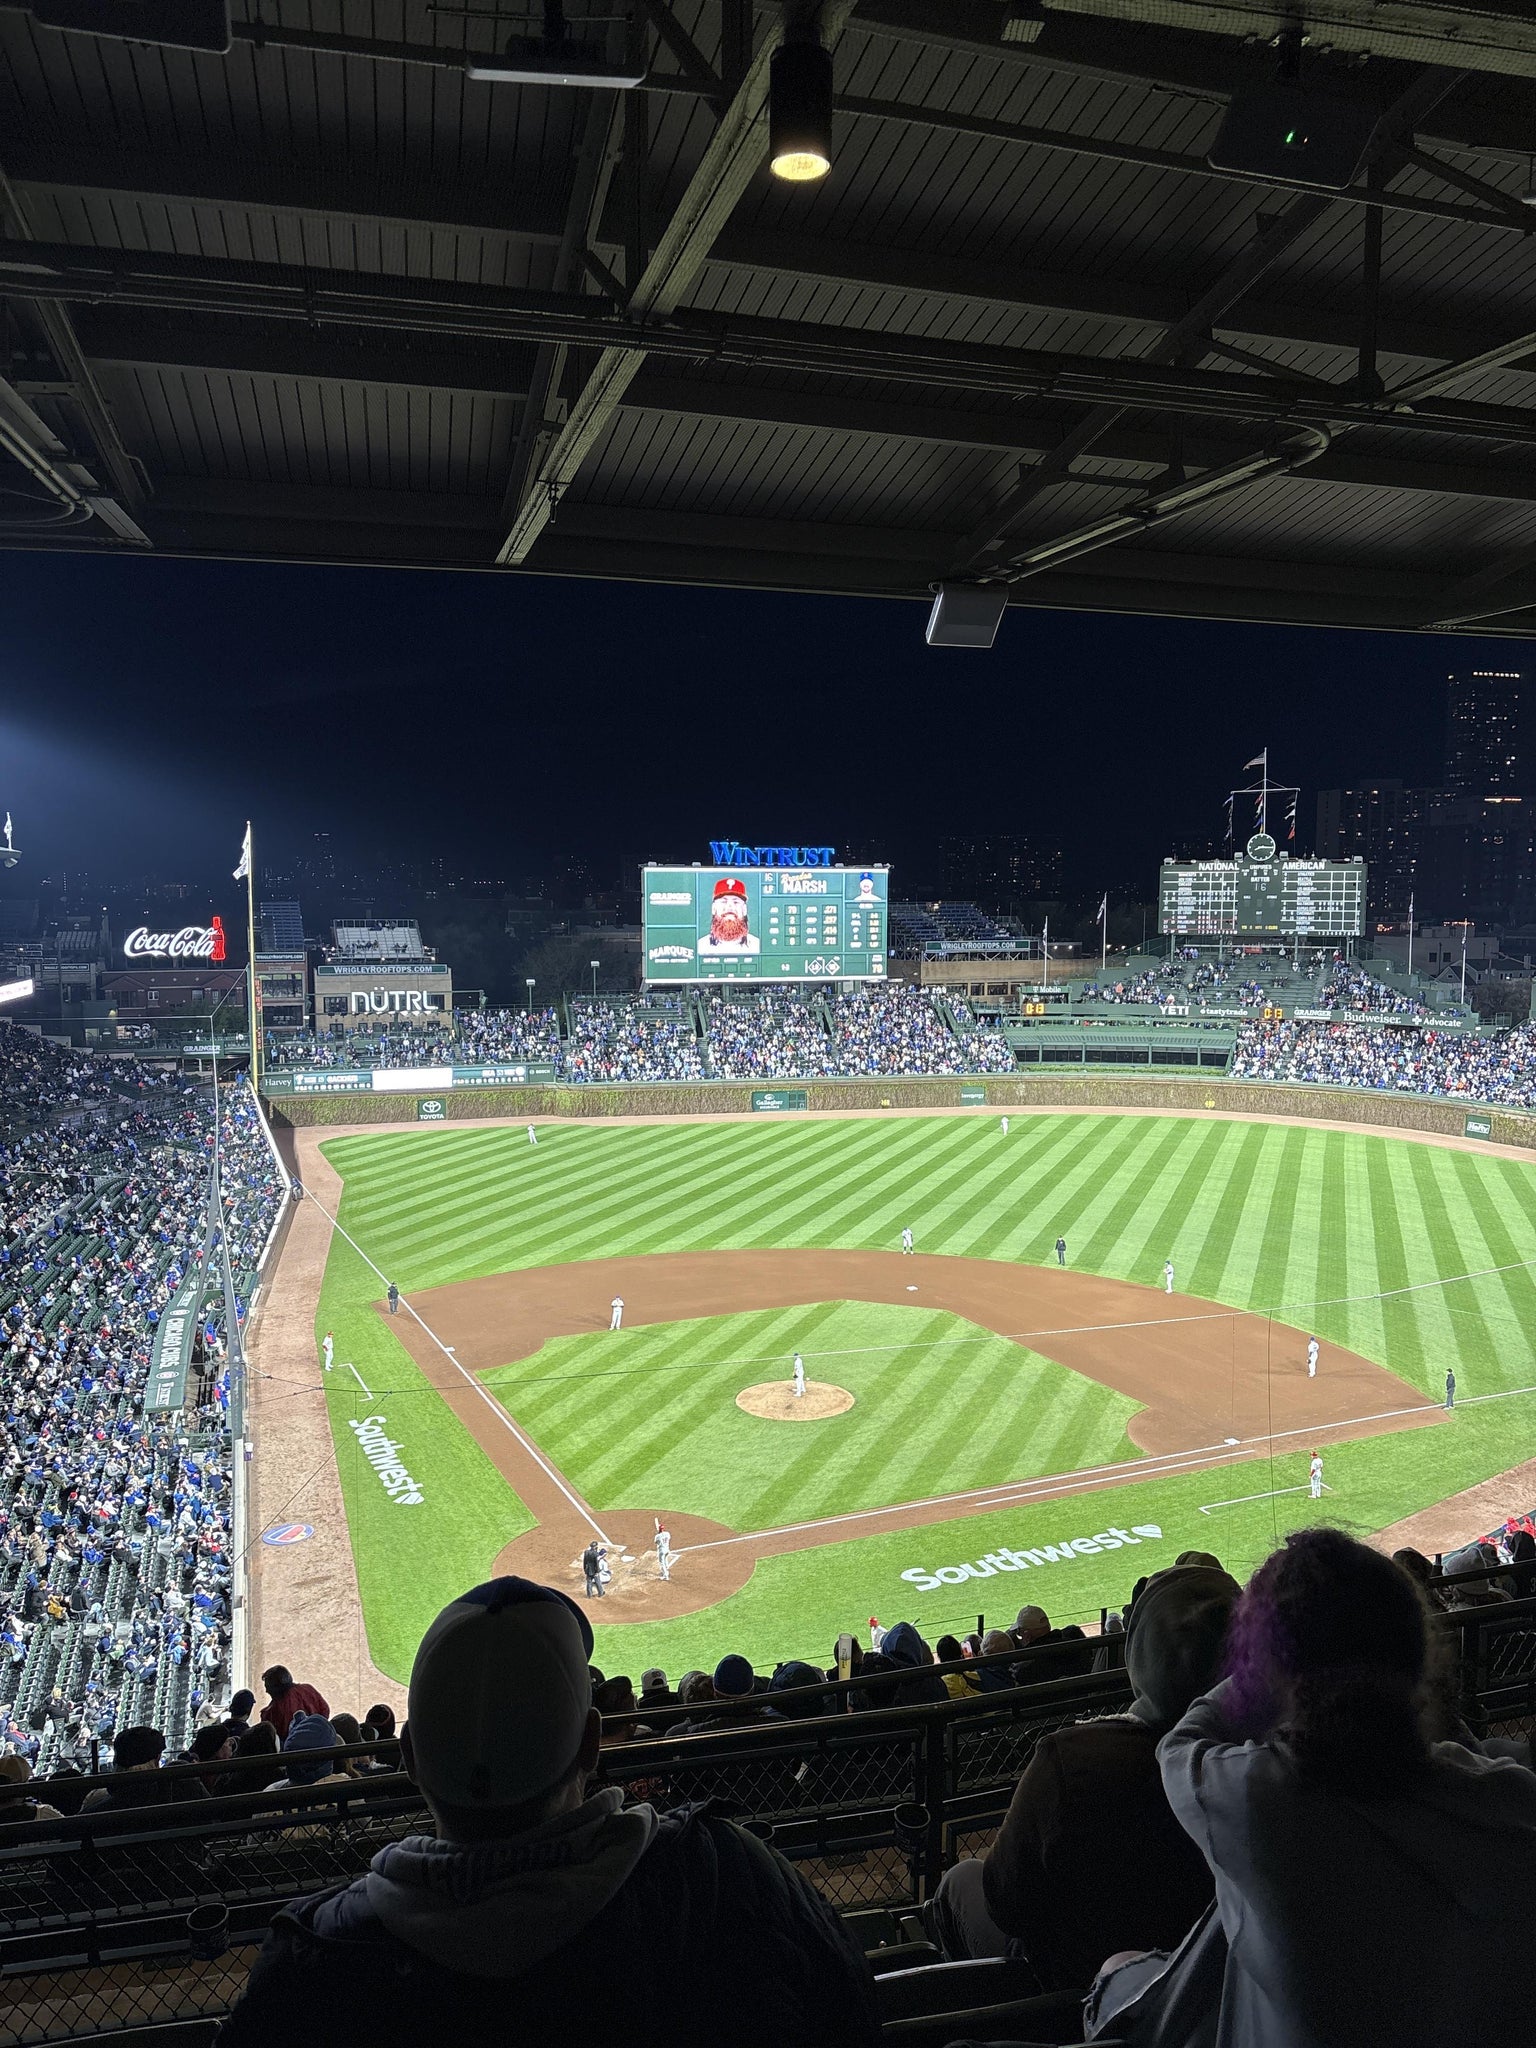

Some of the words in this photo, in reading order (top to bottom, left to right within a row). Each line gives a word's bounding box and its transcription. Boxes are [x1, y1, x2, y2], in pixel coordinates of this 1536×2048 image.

[709, 841, 835, 866] WINTRUST
[1198, 862, 1240, 870] NATIONAL
[1282, 862, 1326, 870] AMERICAN
[783, 880, 827, 894] MARSH
[124, 926, 218, 958] Coca-Cola
[940, 940, 1016, 950] WRIGLEYROOFTOPS.COM
[649, 946, 694, 960] MARQUEE
[1159, 1005, 1190, 1016] YETI
[1206, 1007, 1248, 1017] tastytrade
[1423, 1018, 1462, 1027] Advocate
[265, 1078, 292, 1088] Harvey
[162, 1318, 185, 1347] CHICAGO
[348, 1416, 424, 1496] Southwest
[900, 1527, 1142, 1592] Southwest
